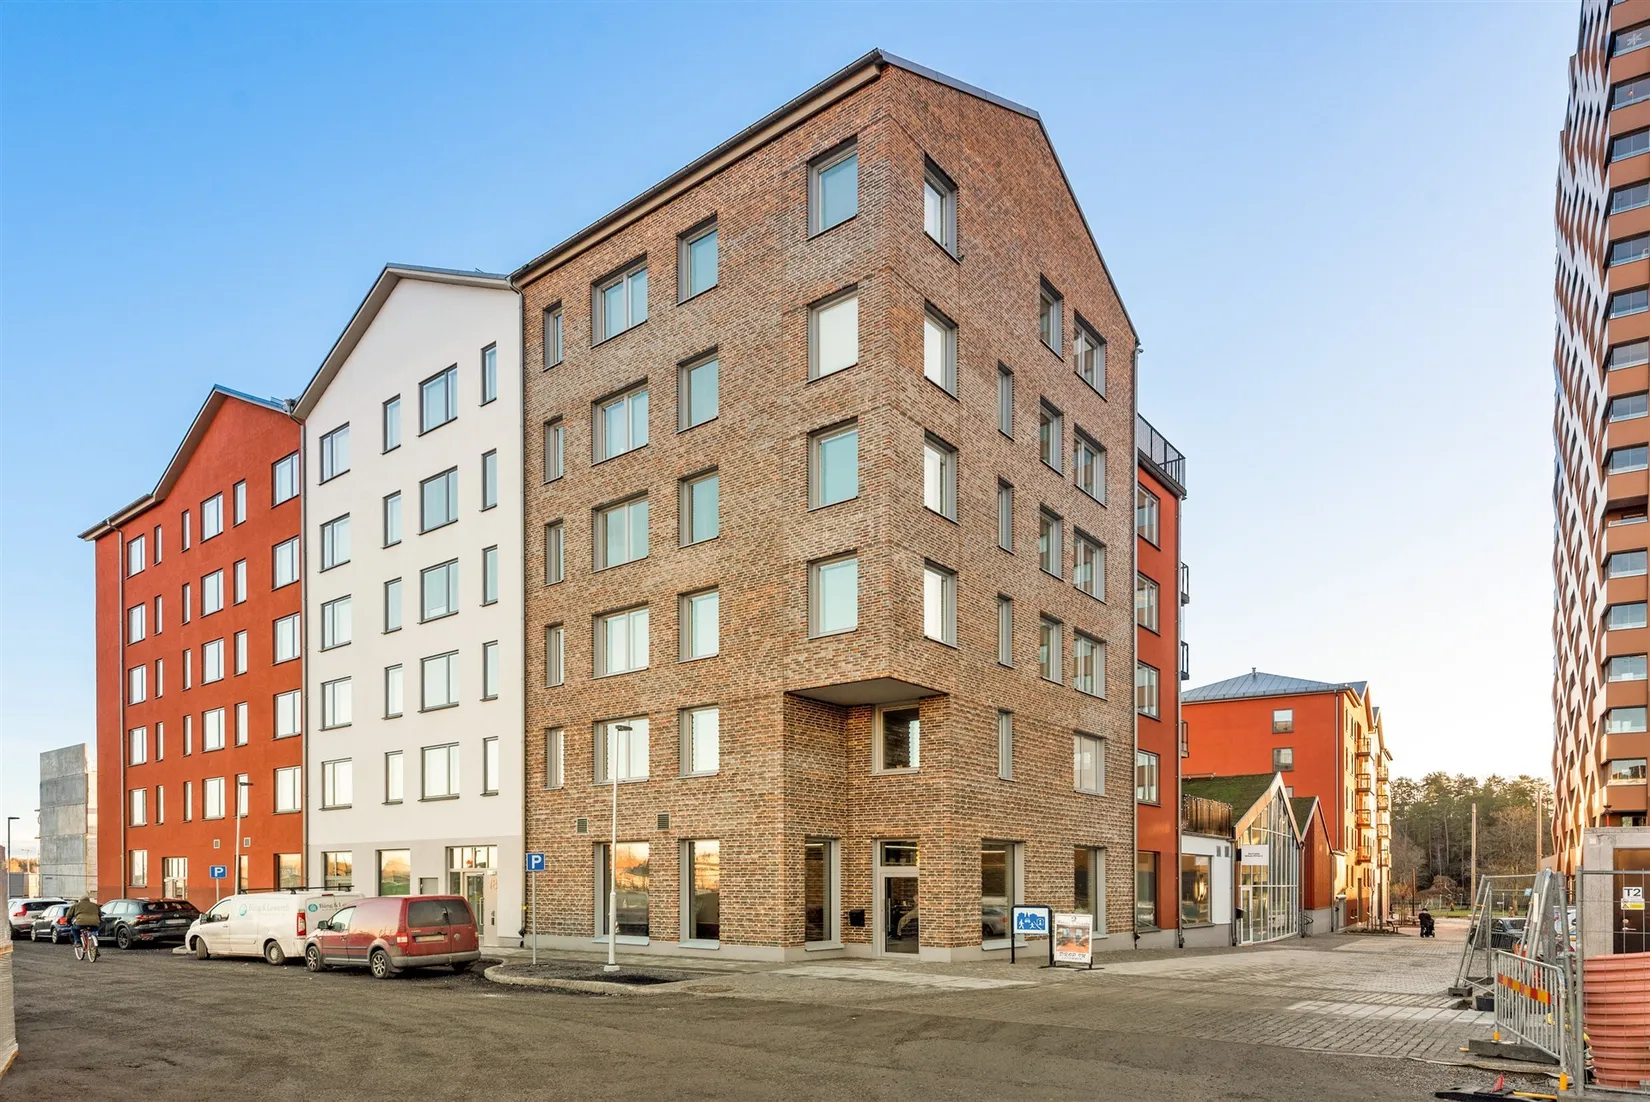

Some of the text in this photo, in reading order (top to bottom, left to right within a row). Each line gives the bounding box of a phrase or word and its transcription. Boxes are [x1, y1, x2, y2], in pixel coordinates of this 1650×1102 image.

[532, 854, 542, 869] P
[214, 867, 224, 877] P
[1624, 888, 1641, 897] T2
